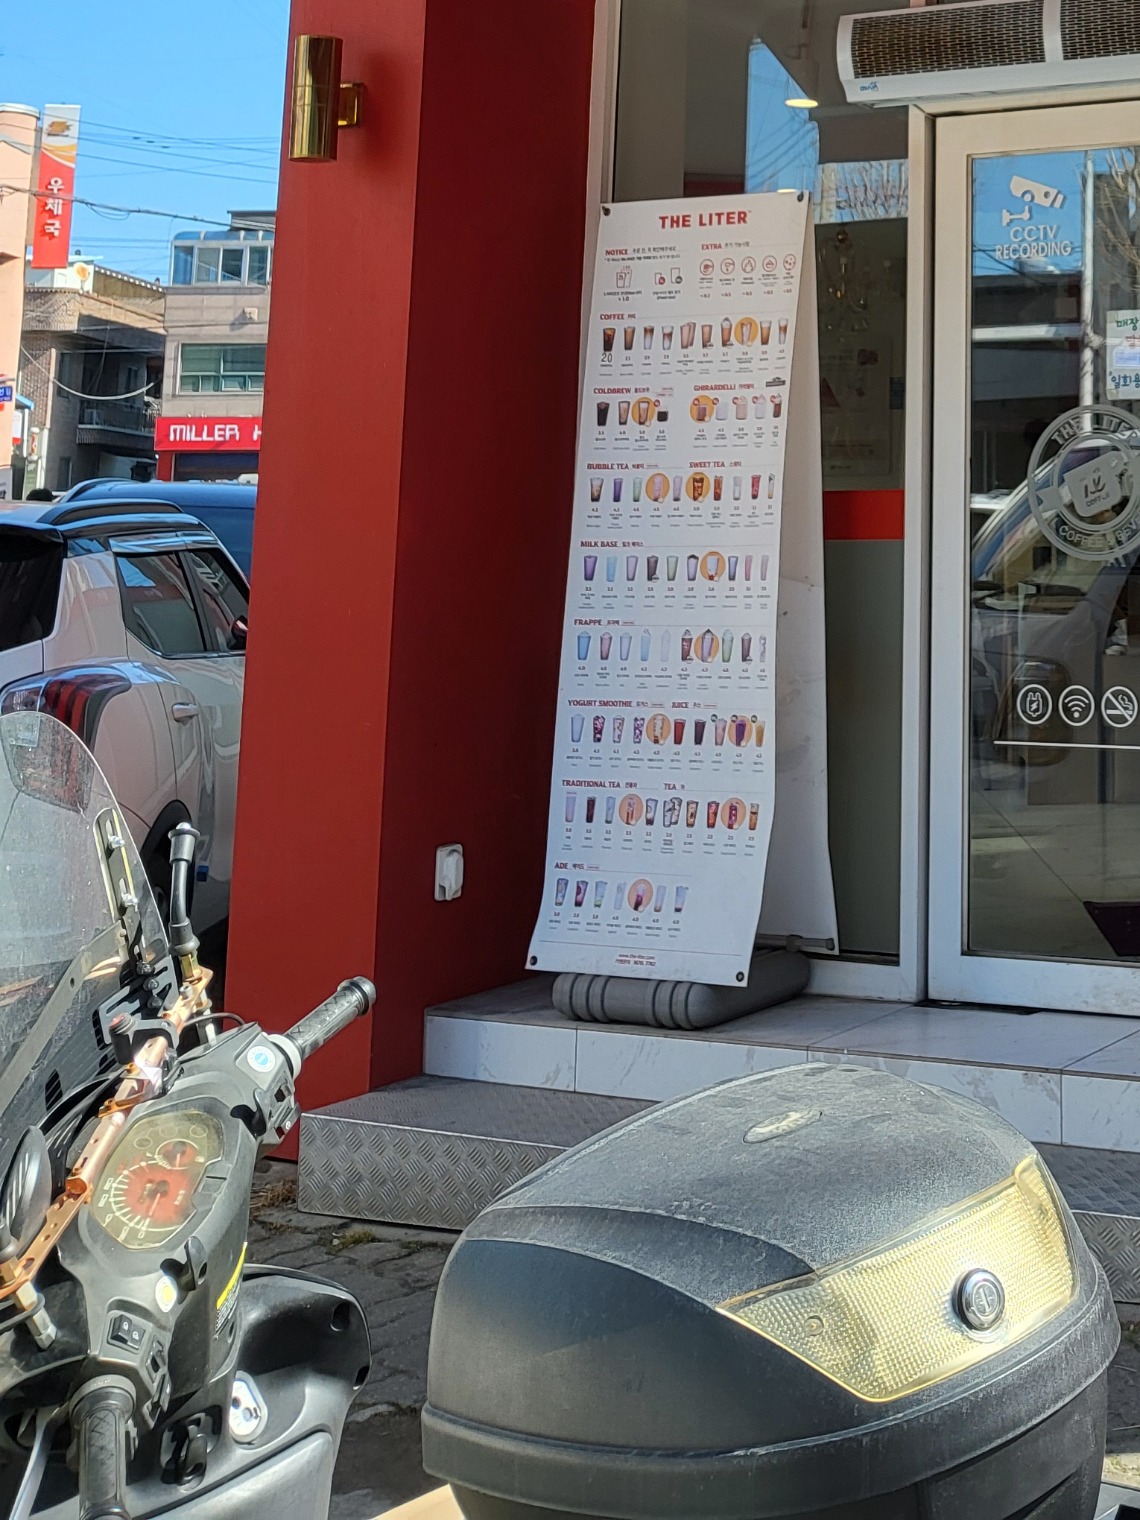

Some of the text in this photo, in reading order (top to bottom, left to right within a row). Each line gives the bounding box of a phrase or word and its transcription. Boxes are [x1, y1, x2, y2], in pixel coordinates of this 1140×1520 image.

[44, 177, 65, 237] 우체국
[659, 210, 748, 229] THE LITER
[1010, 224, 1057, 241] CCTV
[995, 240, 1072, 259] RECORDING
[599, 313, 625, 321] COFFEE
[169, 424, 240, 442] MILLER
[1051, 415, 1082, 445] THE
[689, 461, 712, 469] SWEET
[1059, 524, 1105, 548] COFFEE
[568, 699, 598, 707] YOGURT
[562, 779, 607, 788] TRADITIONAL
[554, 862, 568, 870] ADE
